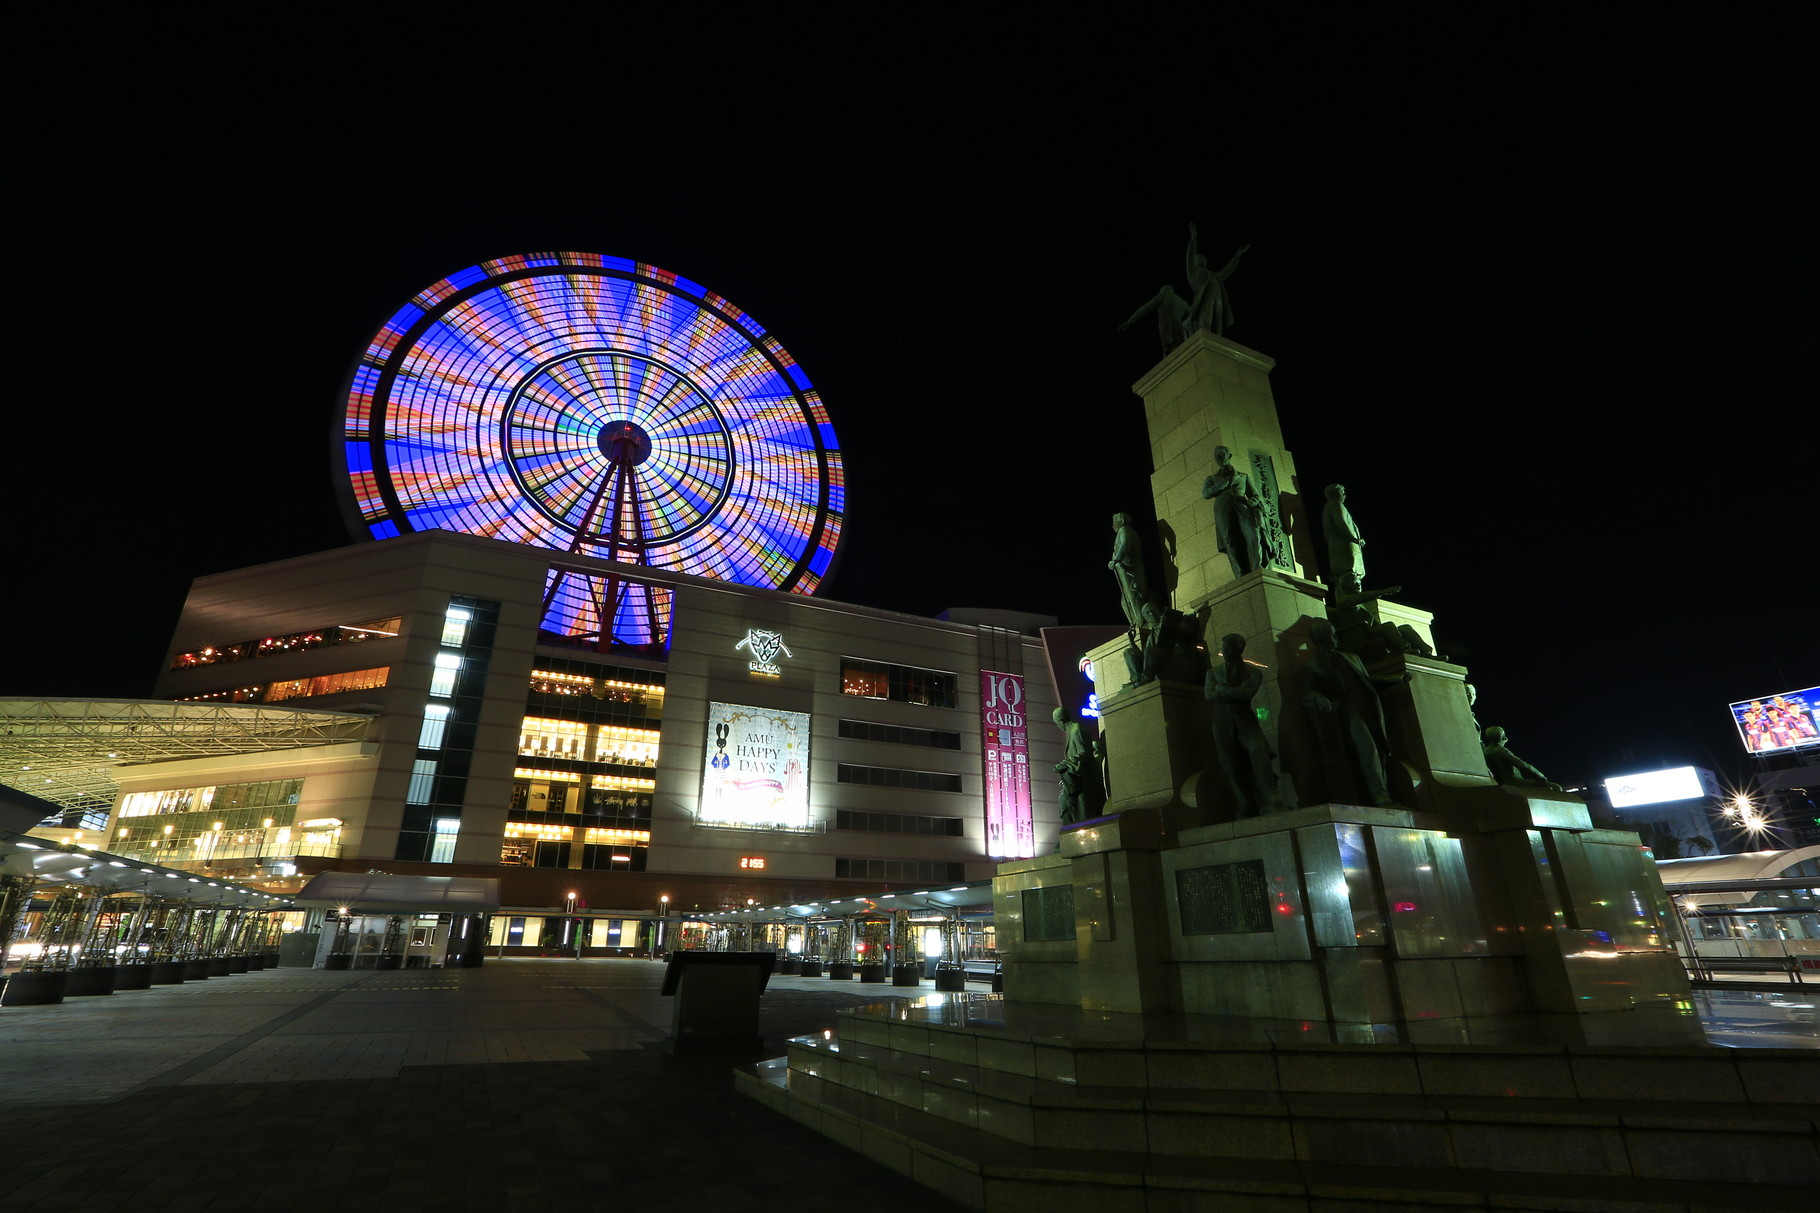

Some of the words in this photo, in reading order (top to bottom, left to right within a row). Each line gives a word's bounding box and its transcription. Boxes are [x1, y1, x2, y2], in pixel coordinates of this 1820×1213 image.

[750, 661, 780, 673] PLAZA
[986, 675, 1021, 714] JQ
[986, 711, 1023, 727] CARD
[745, 733, 774, 744] AMU
[736, 745, 781, 759] HAPPY
[739, 760, 776, 774] DAYS
